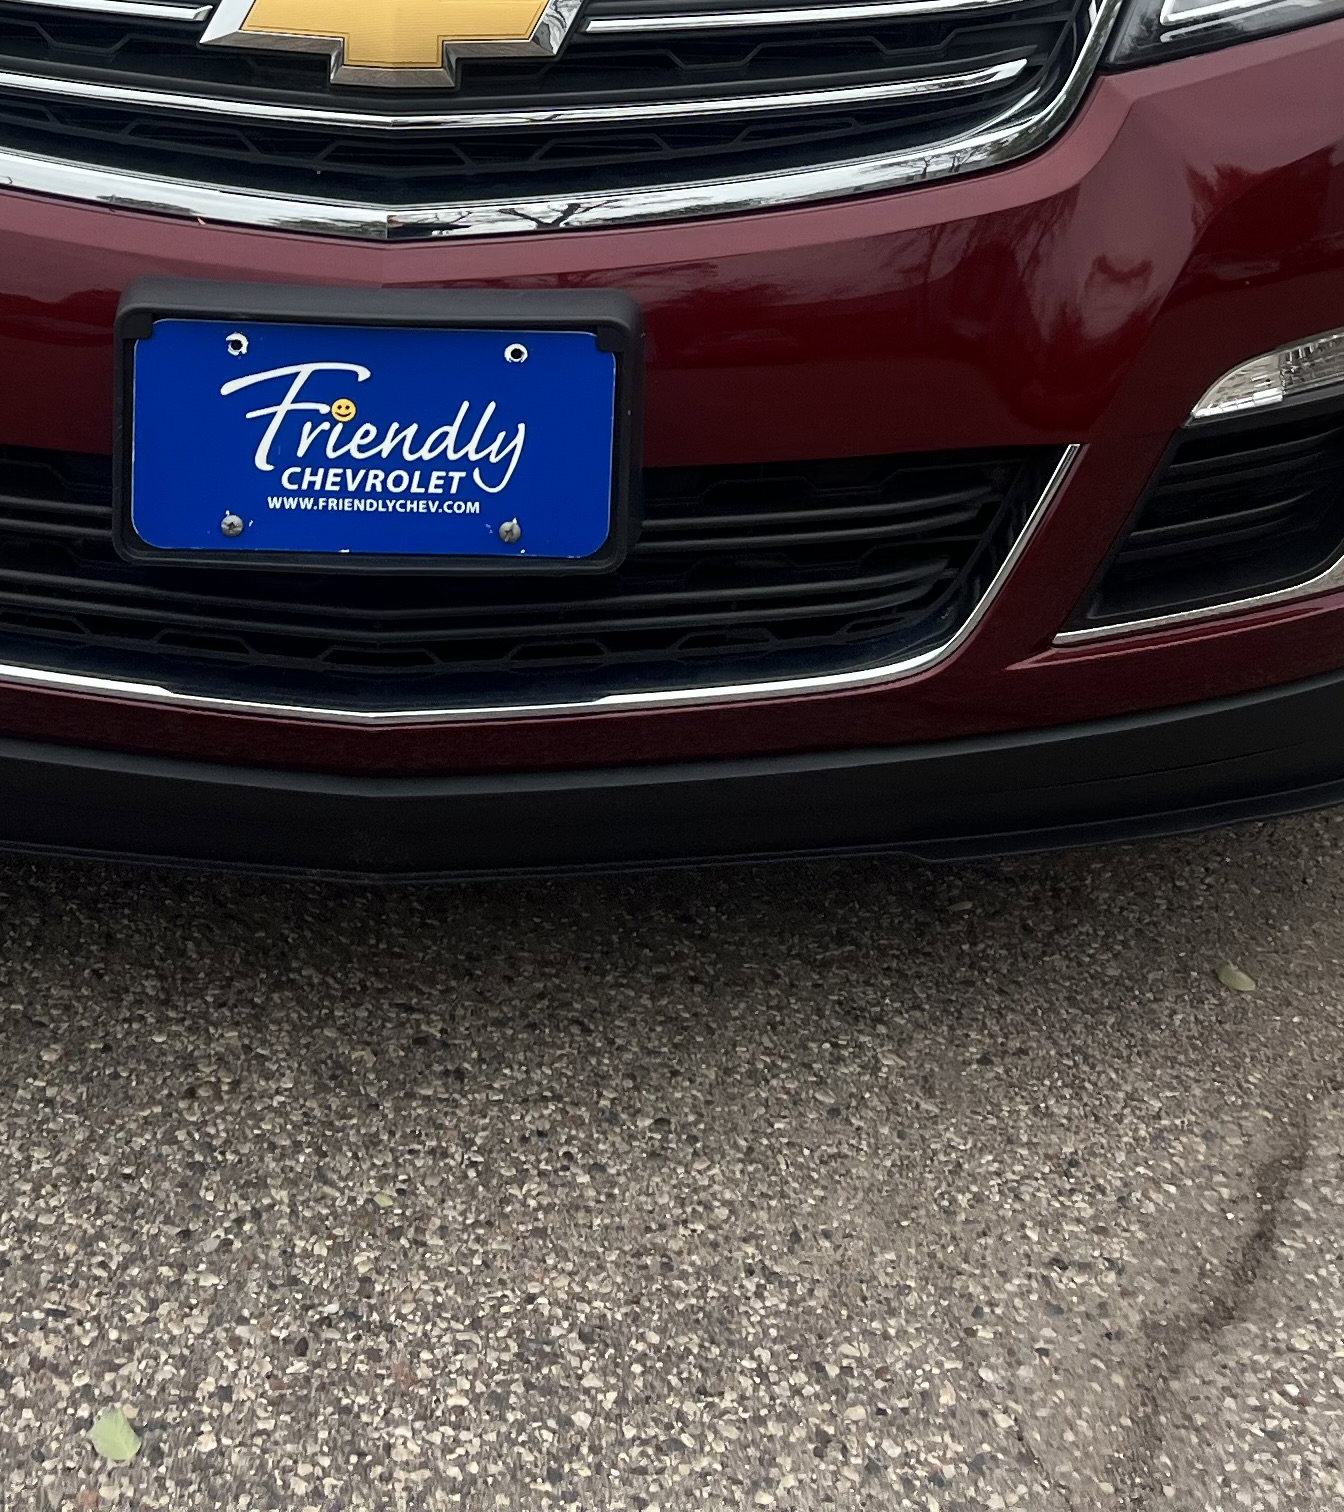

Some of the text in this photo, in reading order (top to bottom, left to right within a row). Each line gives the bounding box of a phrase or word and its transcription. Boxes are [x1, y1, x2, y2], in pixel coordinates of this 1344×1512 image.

[220, 362, 526, 493] Friendly
[281, 466, 467, 494] CHEVROLET
[267, 496, 481, 514] WWW.FRIENDLYCHEV.COM
